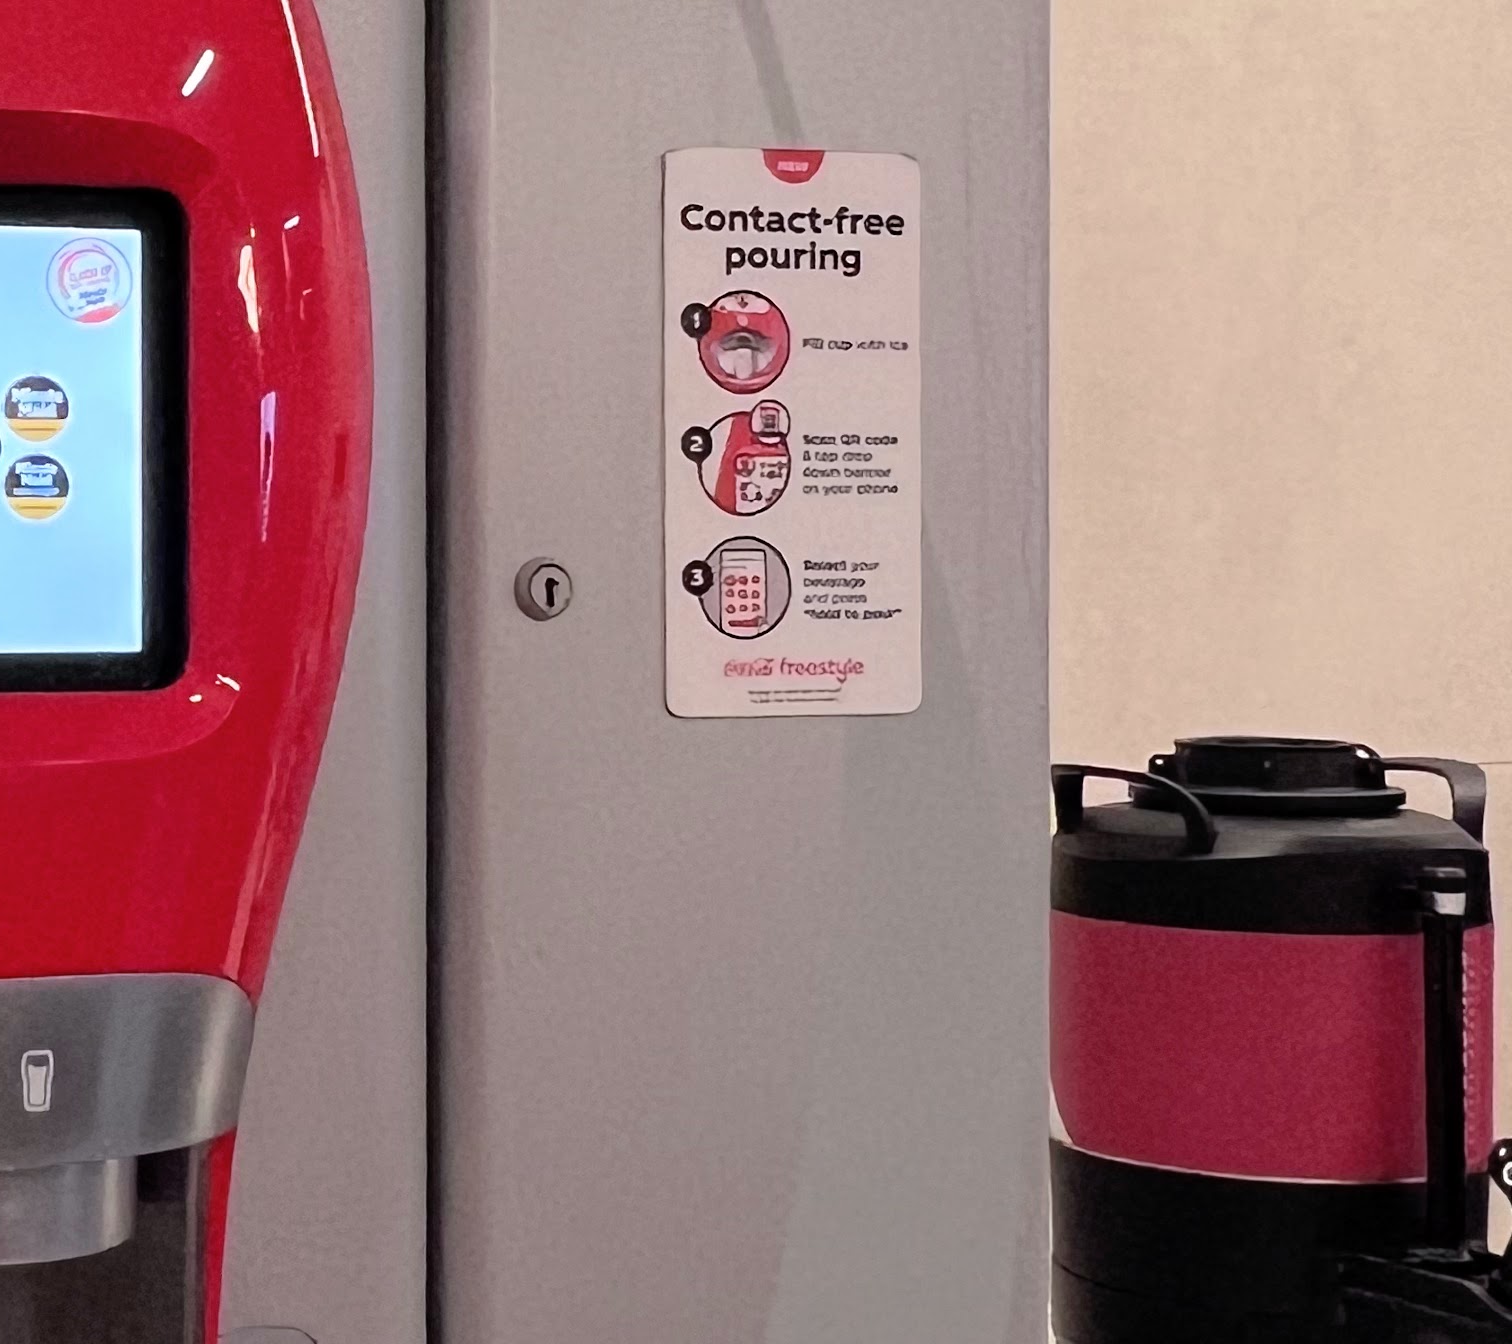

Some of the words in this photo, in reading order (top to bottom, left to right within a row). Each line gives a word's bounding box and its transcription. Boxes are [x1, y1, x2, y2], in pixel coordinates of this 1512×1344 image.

[679, 203, 905, 236] Contact-free
[725, 241, 862, 277] pouring
[689, 436, 704, 453] 2
[690, 568, 705, 587] 3
[780, 658, 865, 684] freestyle
